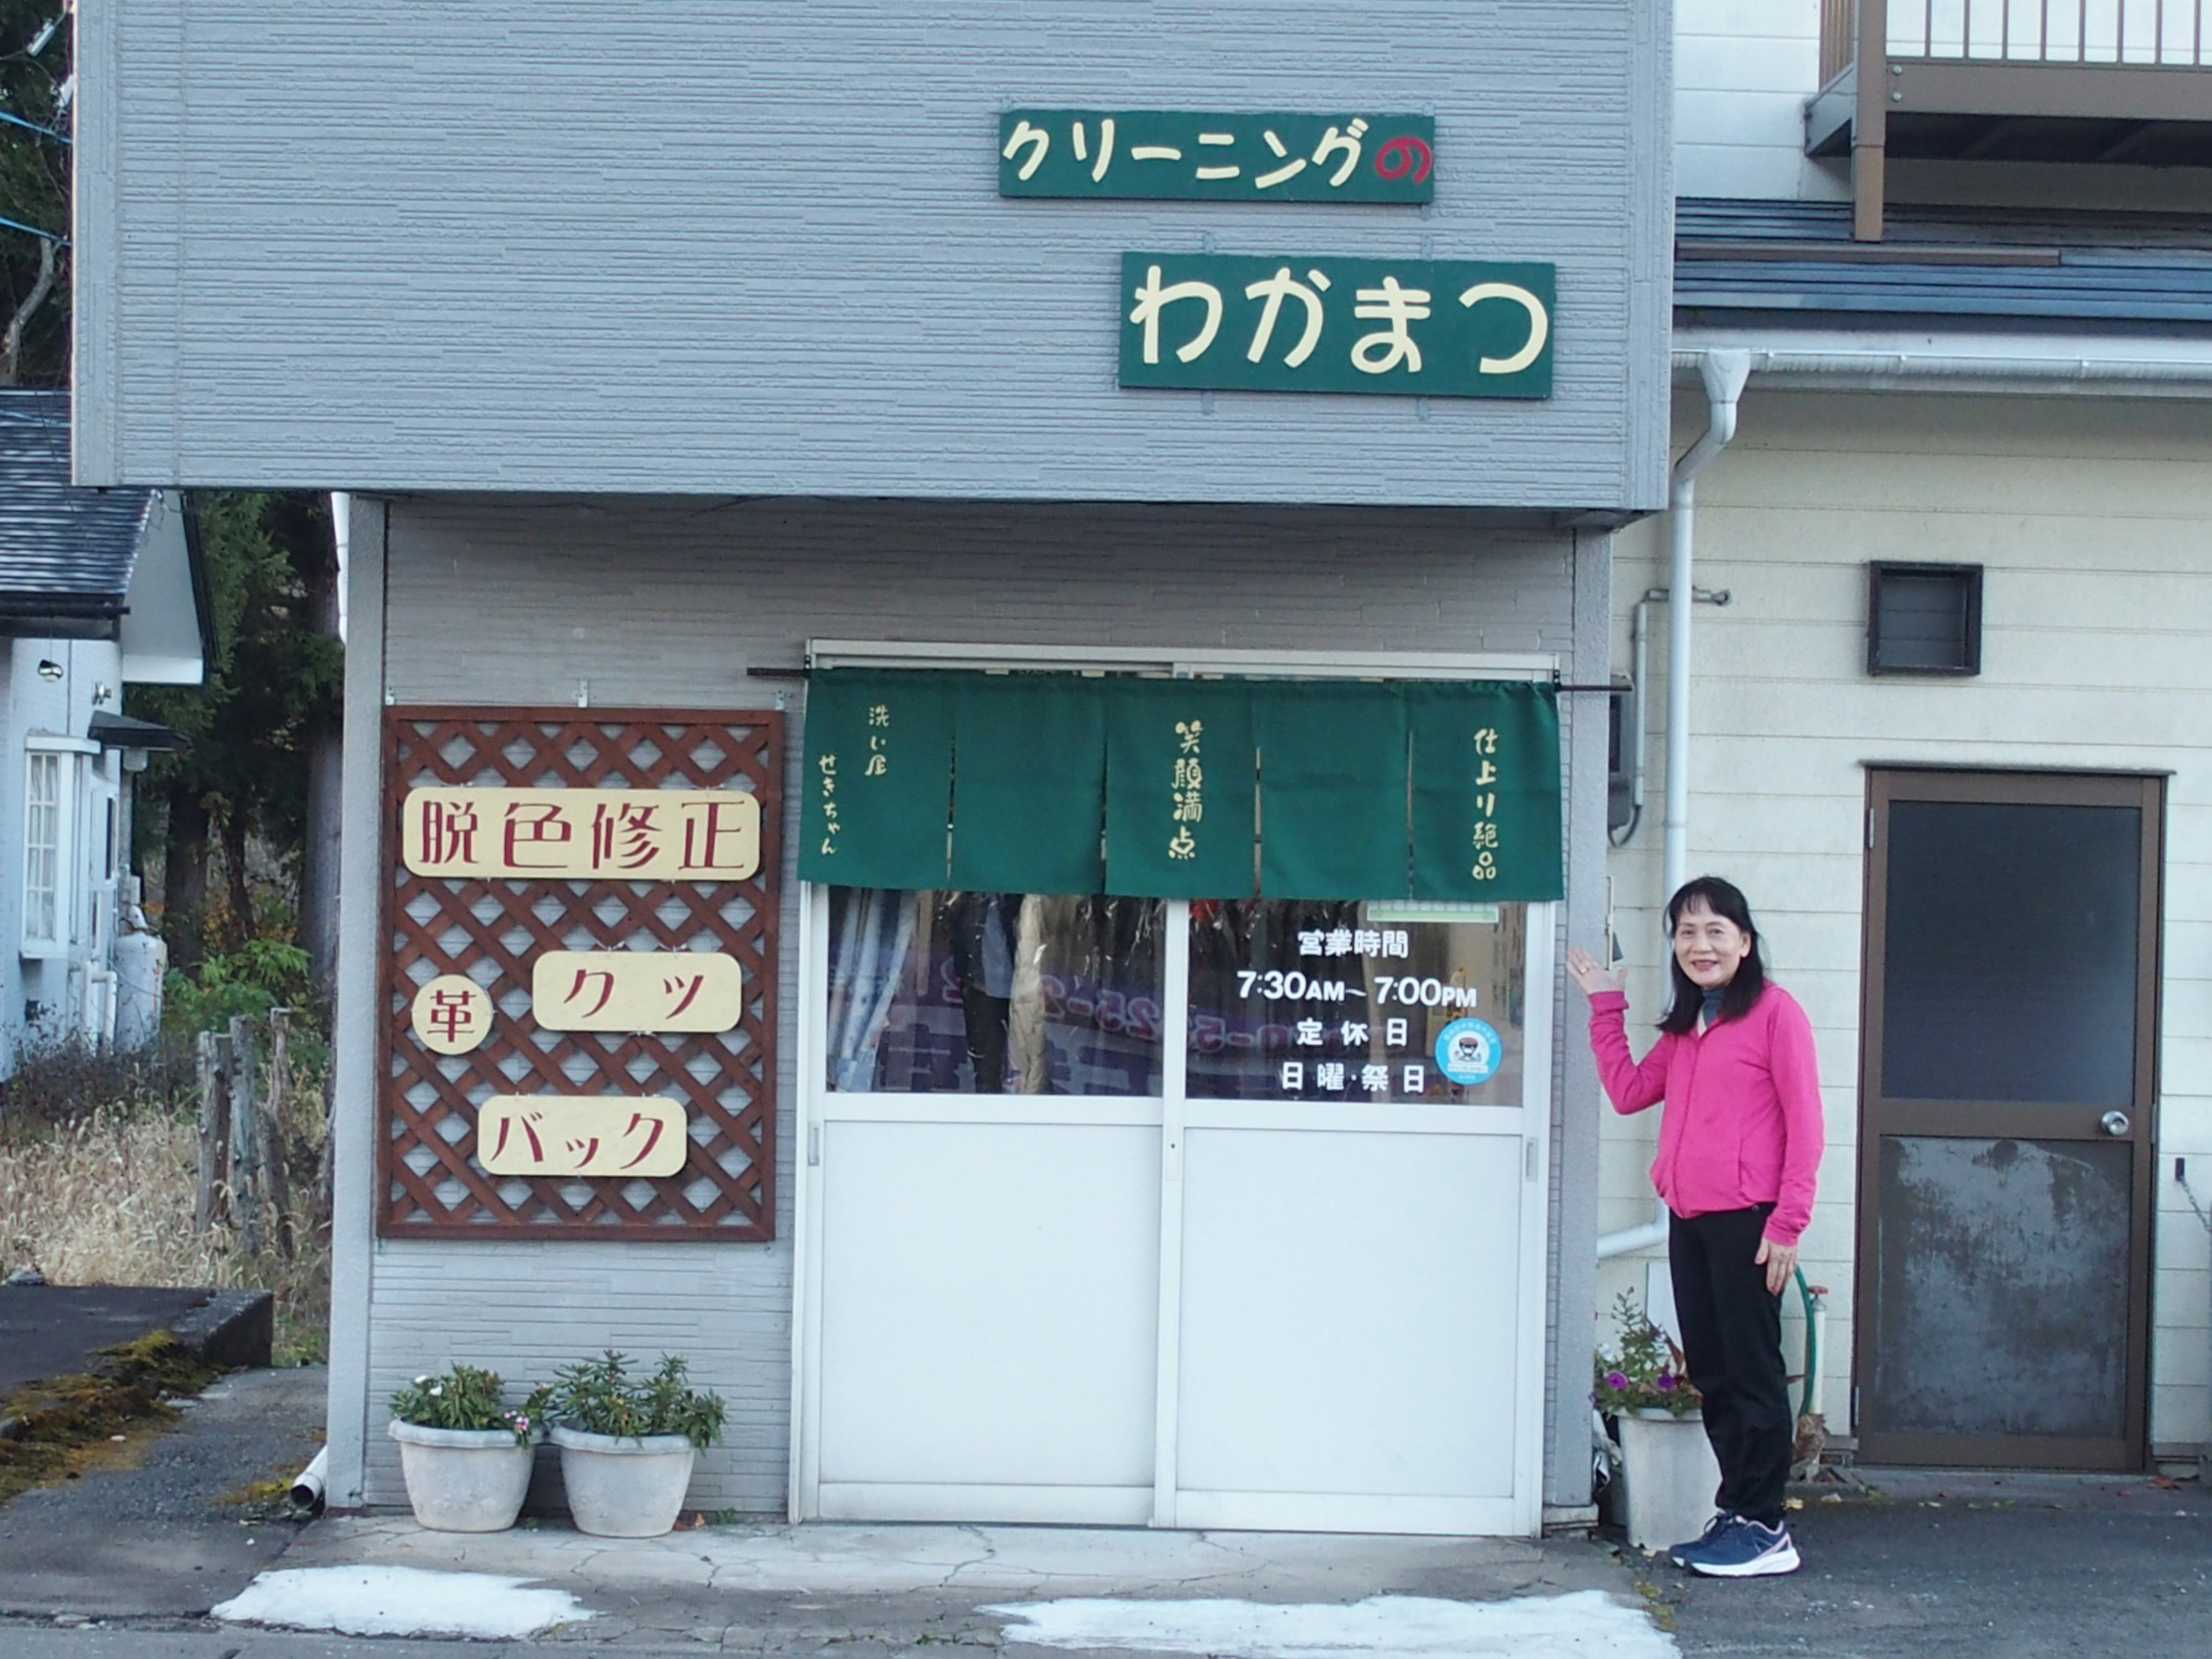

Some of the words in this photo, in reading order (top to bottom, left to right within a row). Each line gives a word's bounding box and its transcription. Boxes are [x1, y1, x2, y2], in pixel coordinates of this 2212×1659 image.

[1003, 118, 1432, 189] クリーニングの
[1129, 265, 1549, 374] わかまつ
[865, 705, 889, 776] 洗い屋
[818, 754, 841, 854] せきちゃん
[1168, 720, 1203, 860] 笑顔満点
[1472, 728, 1499, 880] 仕上り絶品
[418, 800, 746, 870] 脱色修正
[1298, 928, 1409, 959] 営業時間
[426, 989, 477, 1043] 革
[562, 969, 705, 1020] クツ
[1296, 1017, 1408, 1047] 定休日
[490, 1112, 665, 1170] バック
